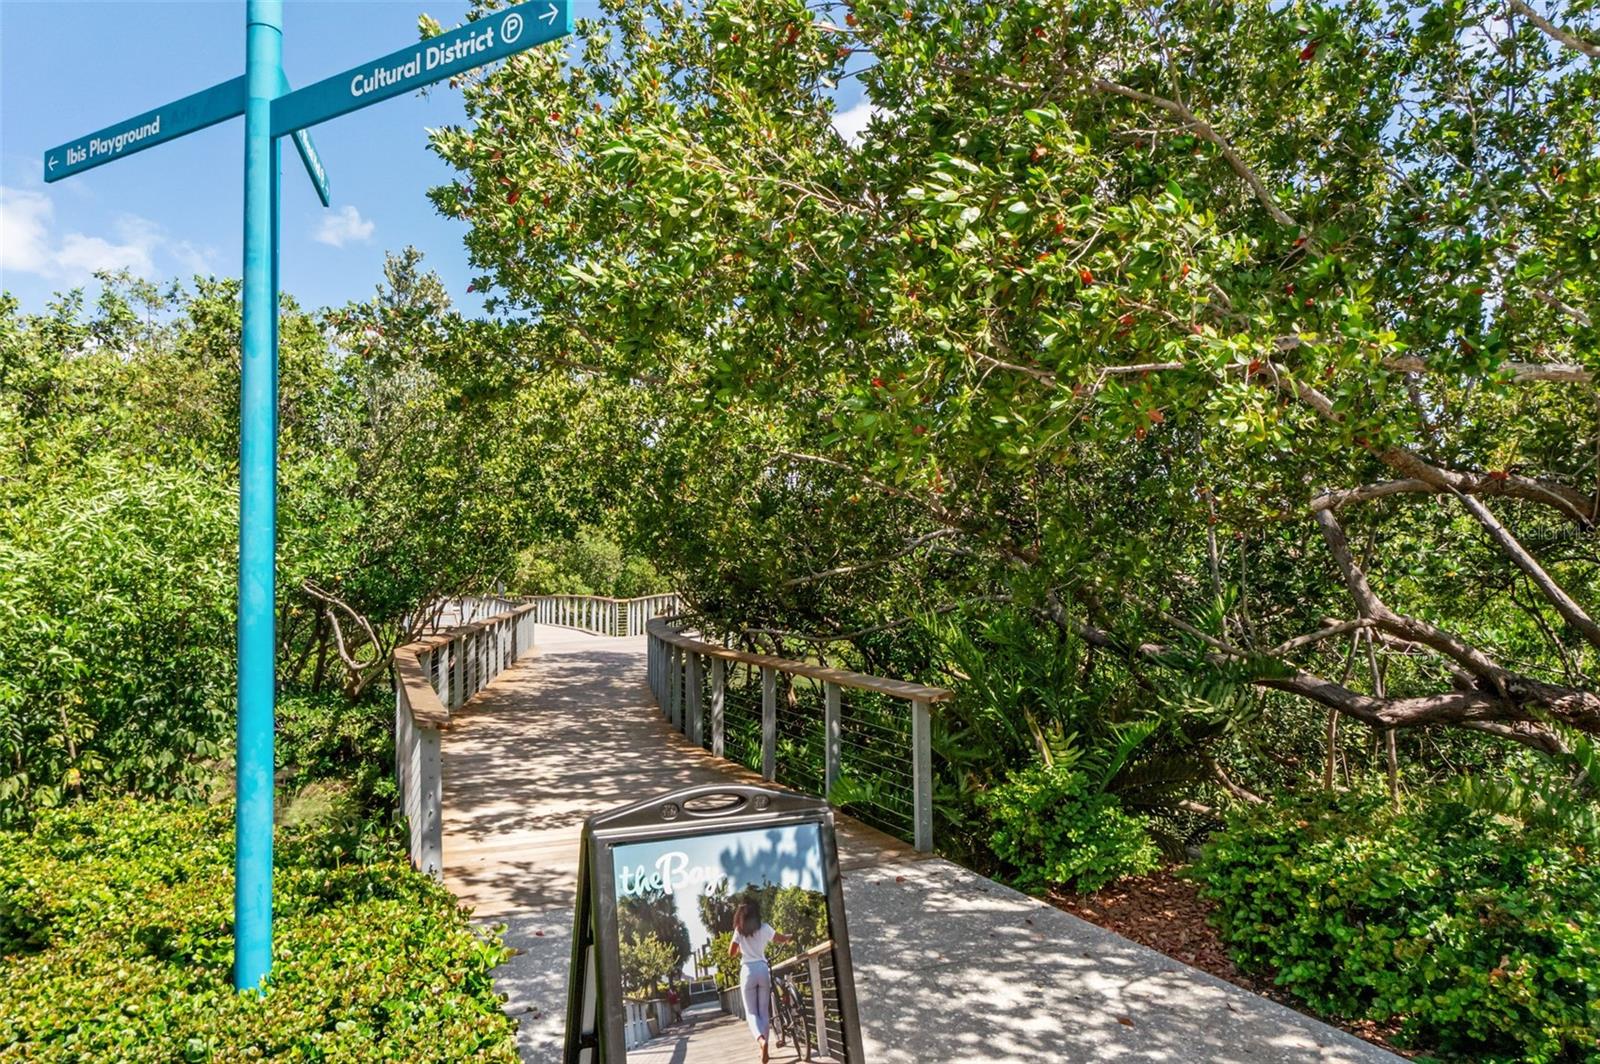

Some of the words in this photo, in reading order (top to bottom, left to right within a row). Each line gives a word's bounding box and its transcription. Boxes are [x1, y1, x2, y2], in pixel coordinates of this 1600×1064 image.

[350, 53, 421, 97] Cultural
[426, 27, 495, 71] District
[66, 146, 87, 166] Ibis
[90, 115, 160, 157] Playground
